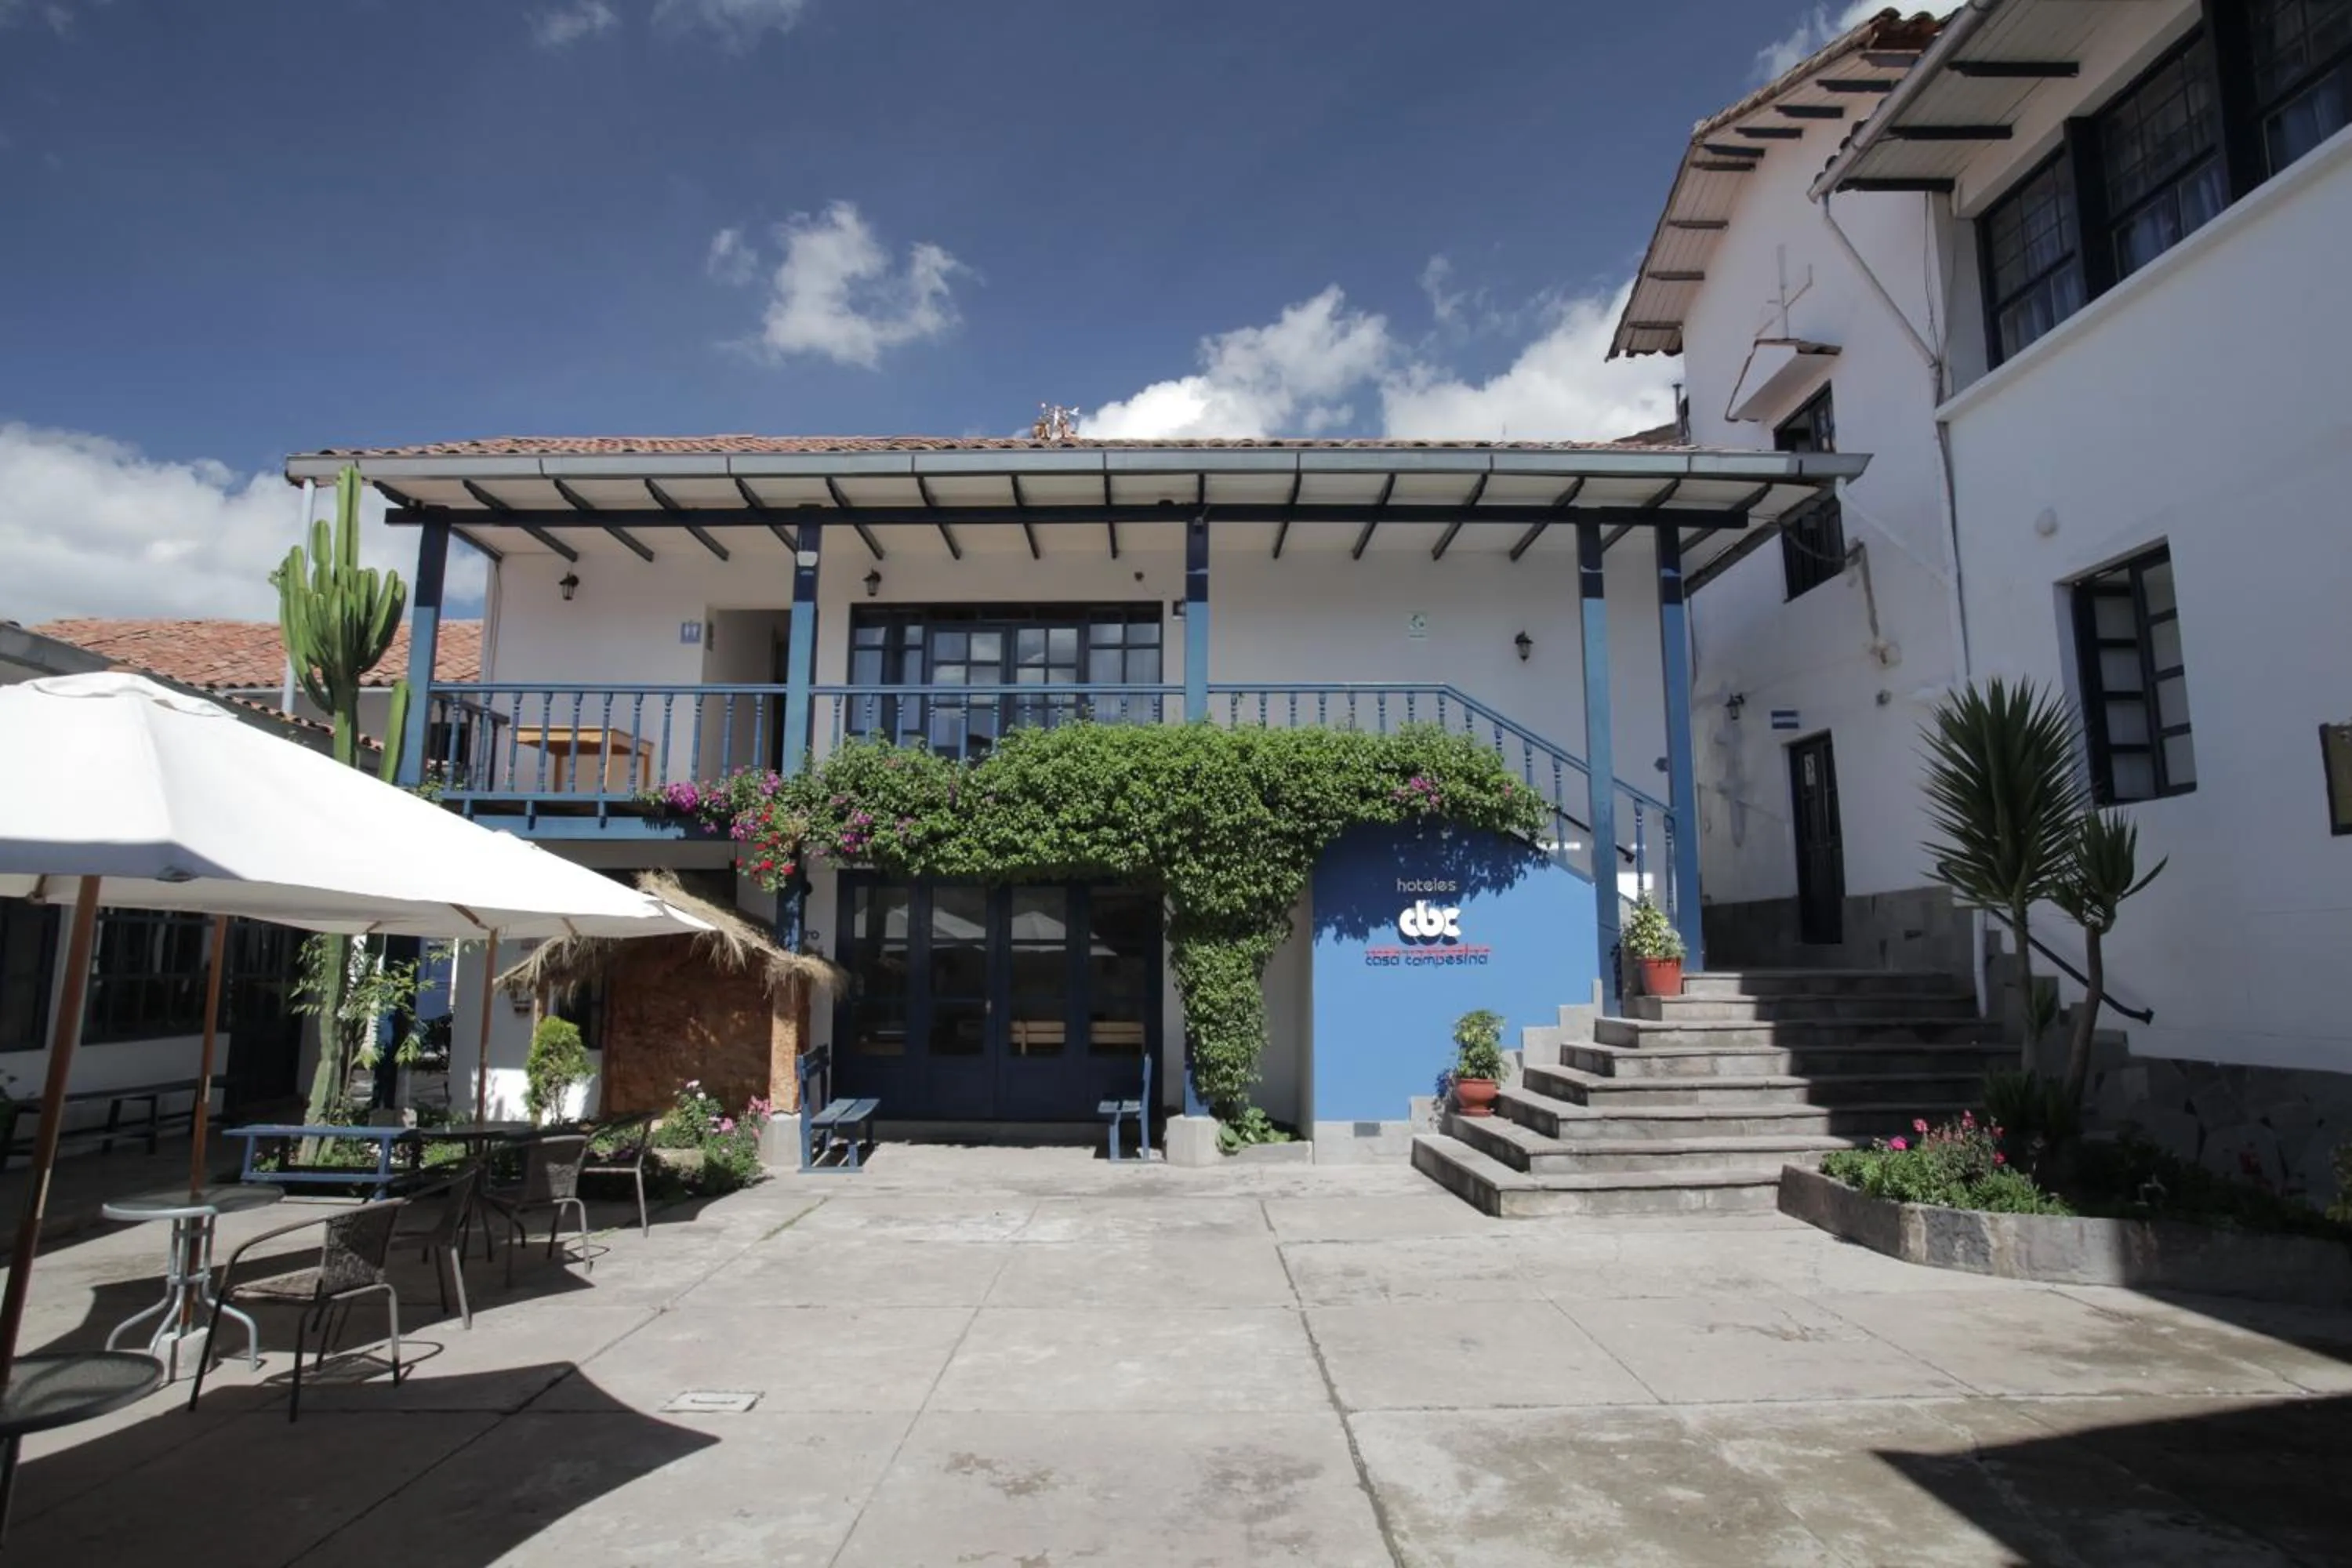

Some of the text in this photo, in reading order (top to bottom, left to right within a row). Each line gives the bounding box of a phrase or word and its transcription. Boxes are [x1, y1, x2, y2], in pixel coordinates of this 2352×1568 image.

[1396, 877, 1457, 892] hoteles
[1365, 947, 1489, 968] casa campesina
